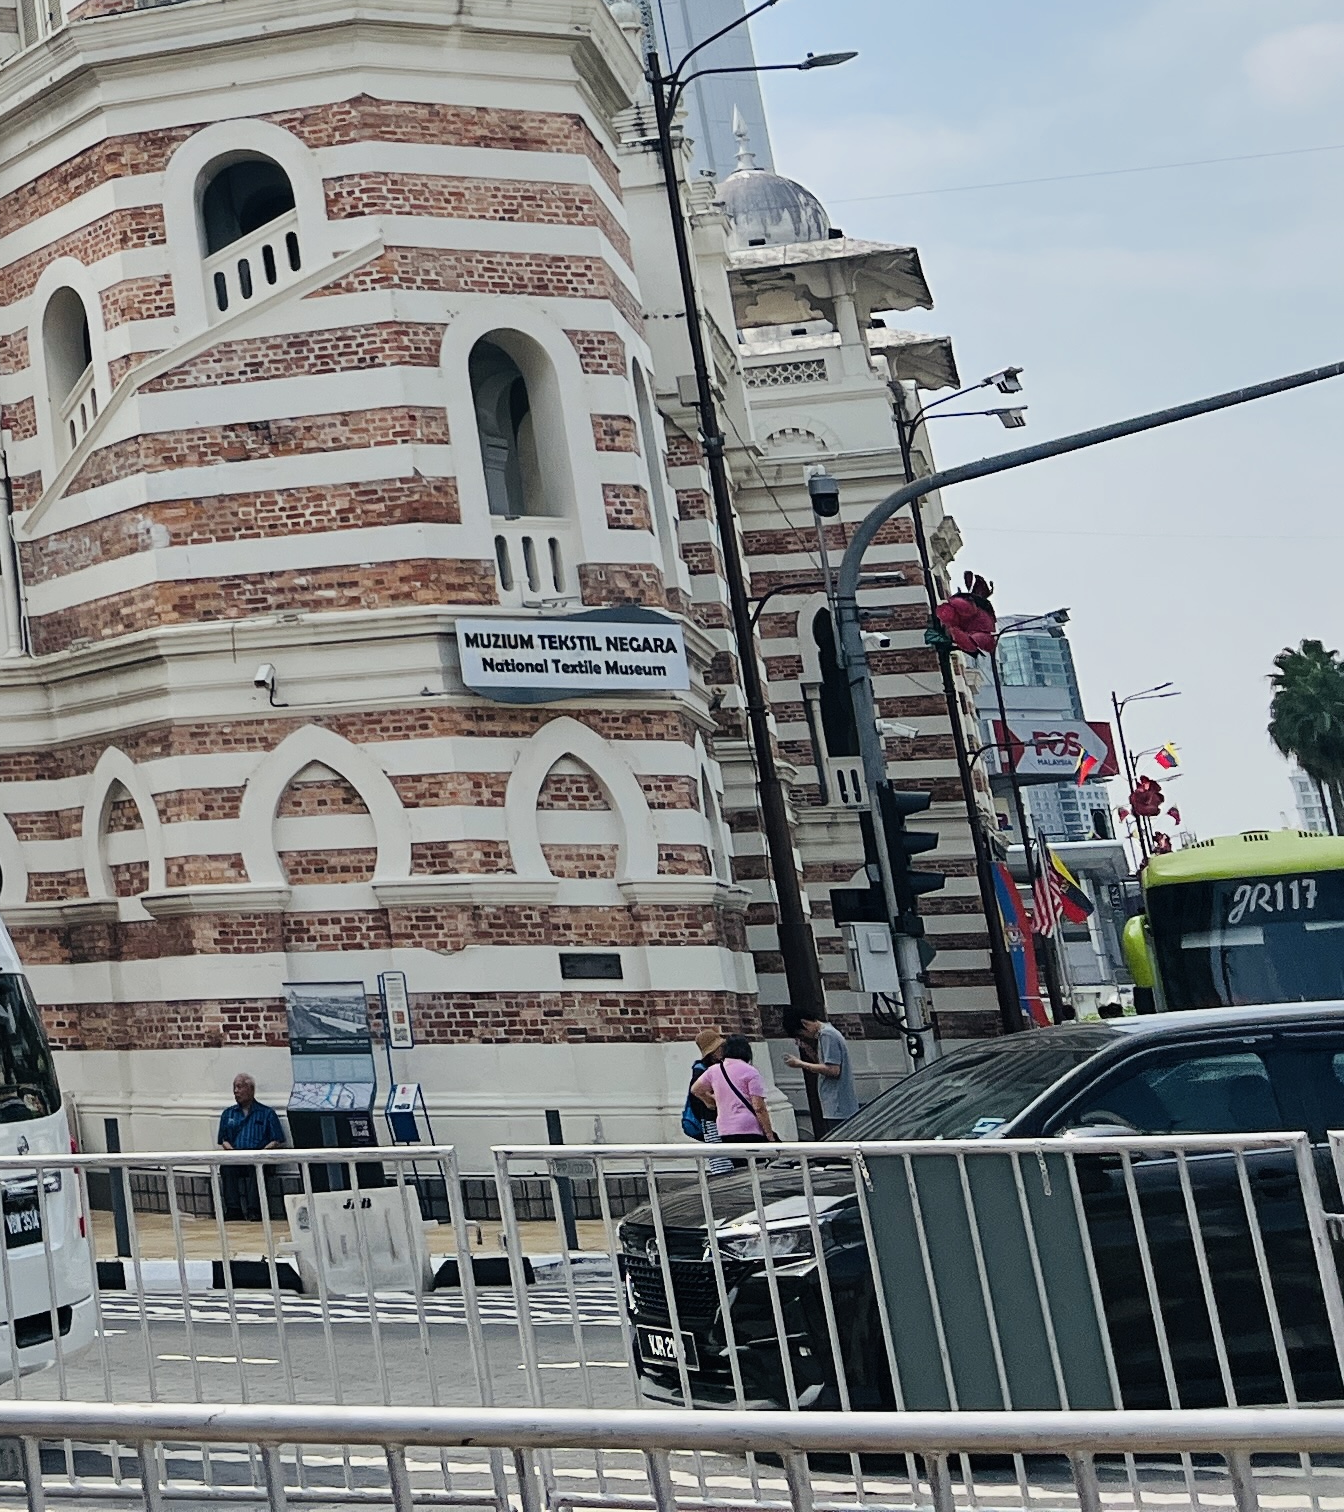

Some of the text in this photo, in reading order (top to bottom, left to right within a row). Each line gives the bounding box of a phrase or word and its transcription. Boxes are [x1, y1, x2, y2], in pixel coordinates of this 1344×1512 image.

[464, 632, 678, 654] MUZIUM TEKSTIL NEGARA
[482, 657, 667, 677] National Textile Museum
[1032, 731, 1081, 757] POS
[1037, 758, 1072, 766] MALAYSIA
[1227, 879, 1318, 924] JR117
